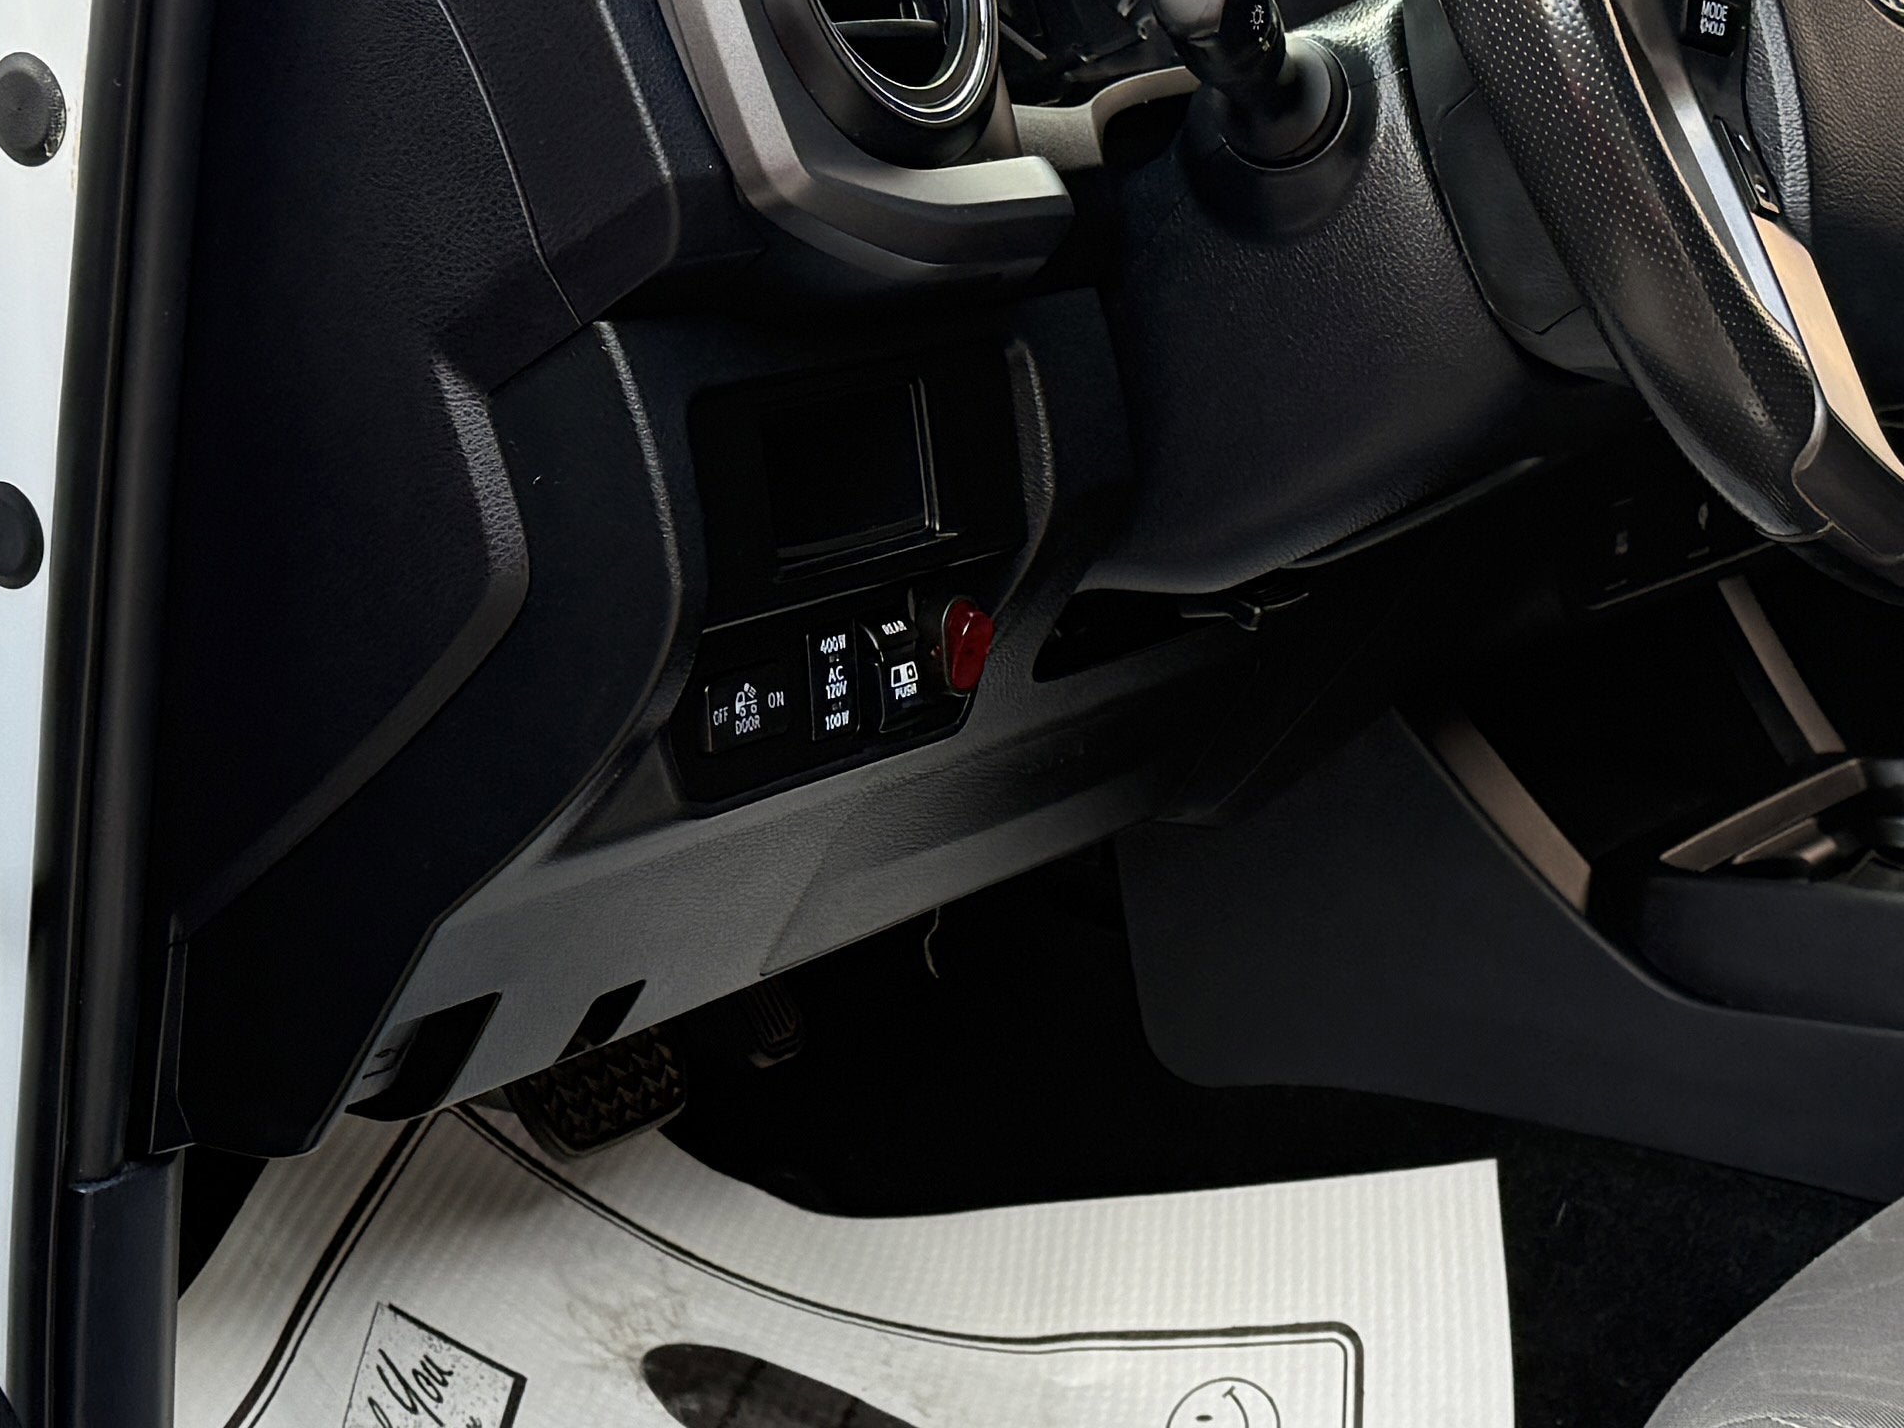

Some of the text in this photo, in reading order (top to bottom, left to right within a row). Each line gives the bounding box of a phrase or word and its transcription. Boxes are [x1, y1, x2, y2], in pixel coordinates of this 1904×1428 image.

[1701, 0, 1729, 22] MODE
[1707, 19, 1726, 37] HOLD
[819, 633, 848, 655] 400W
[827, 665, 846, 684] AC
[825, 679, 848, 700] 120V
[894, 681, 919, 701] PUSH
[712, 690, 785, 727] OFF ON
[734, 714, 762, 736] DOOR
[824, 710, 851, 732] 100W
[376, 1347, 455, 1428] You
